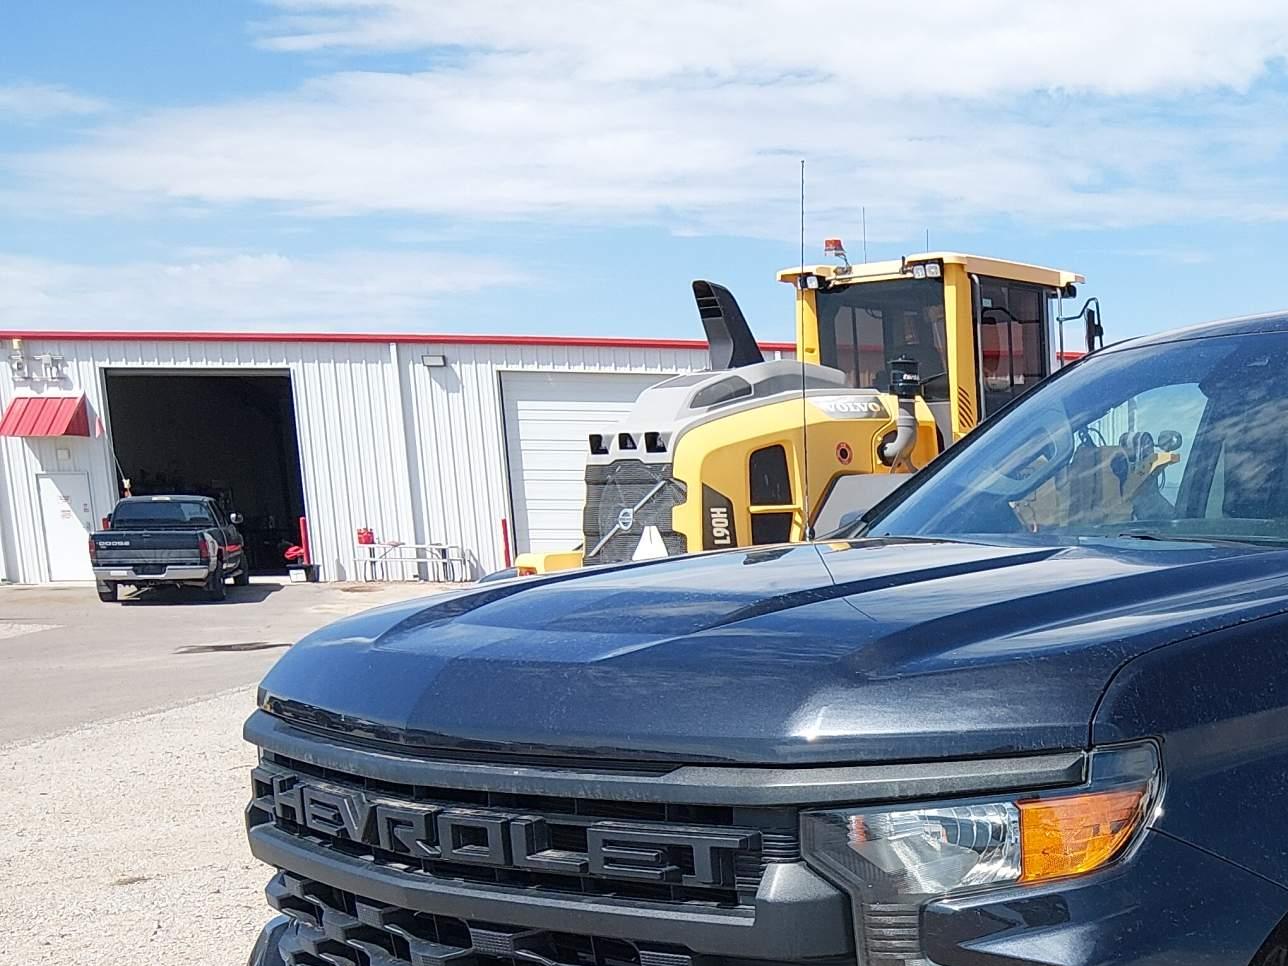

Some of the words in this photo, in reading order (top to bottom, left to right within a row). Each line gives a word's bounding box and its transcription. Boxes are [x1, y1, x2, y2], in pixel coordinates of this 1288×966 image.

[826, 401, 881, 413] VOLVO
[710, 507, 731, 545] L90H
[250, 768, 762, 888] CHEVROLET
